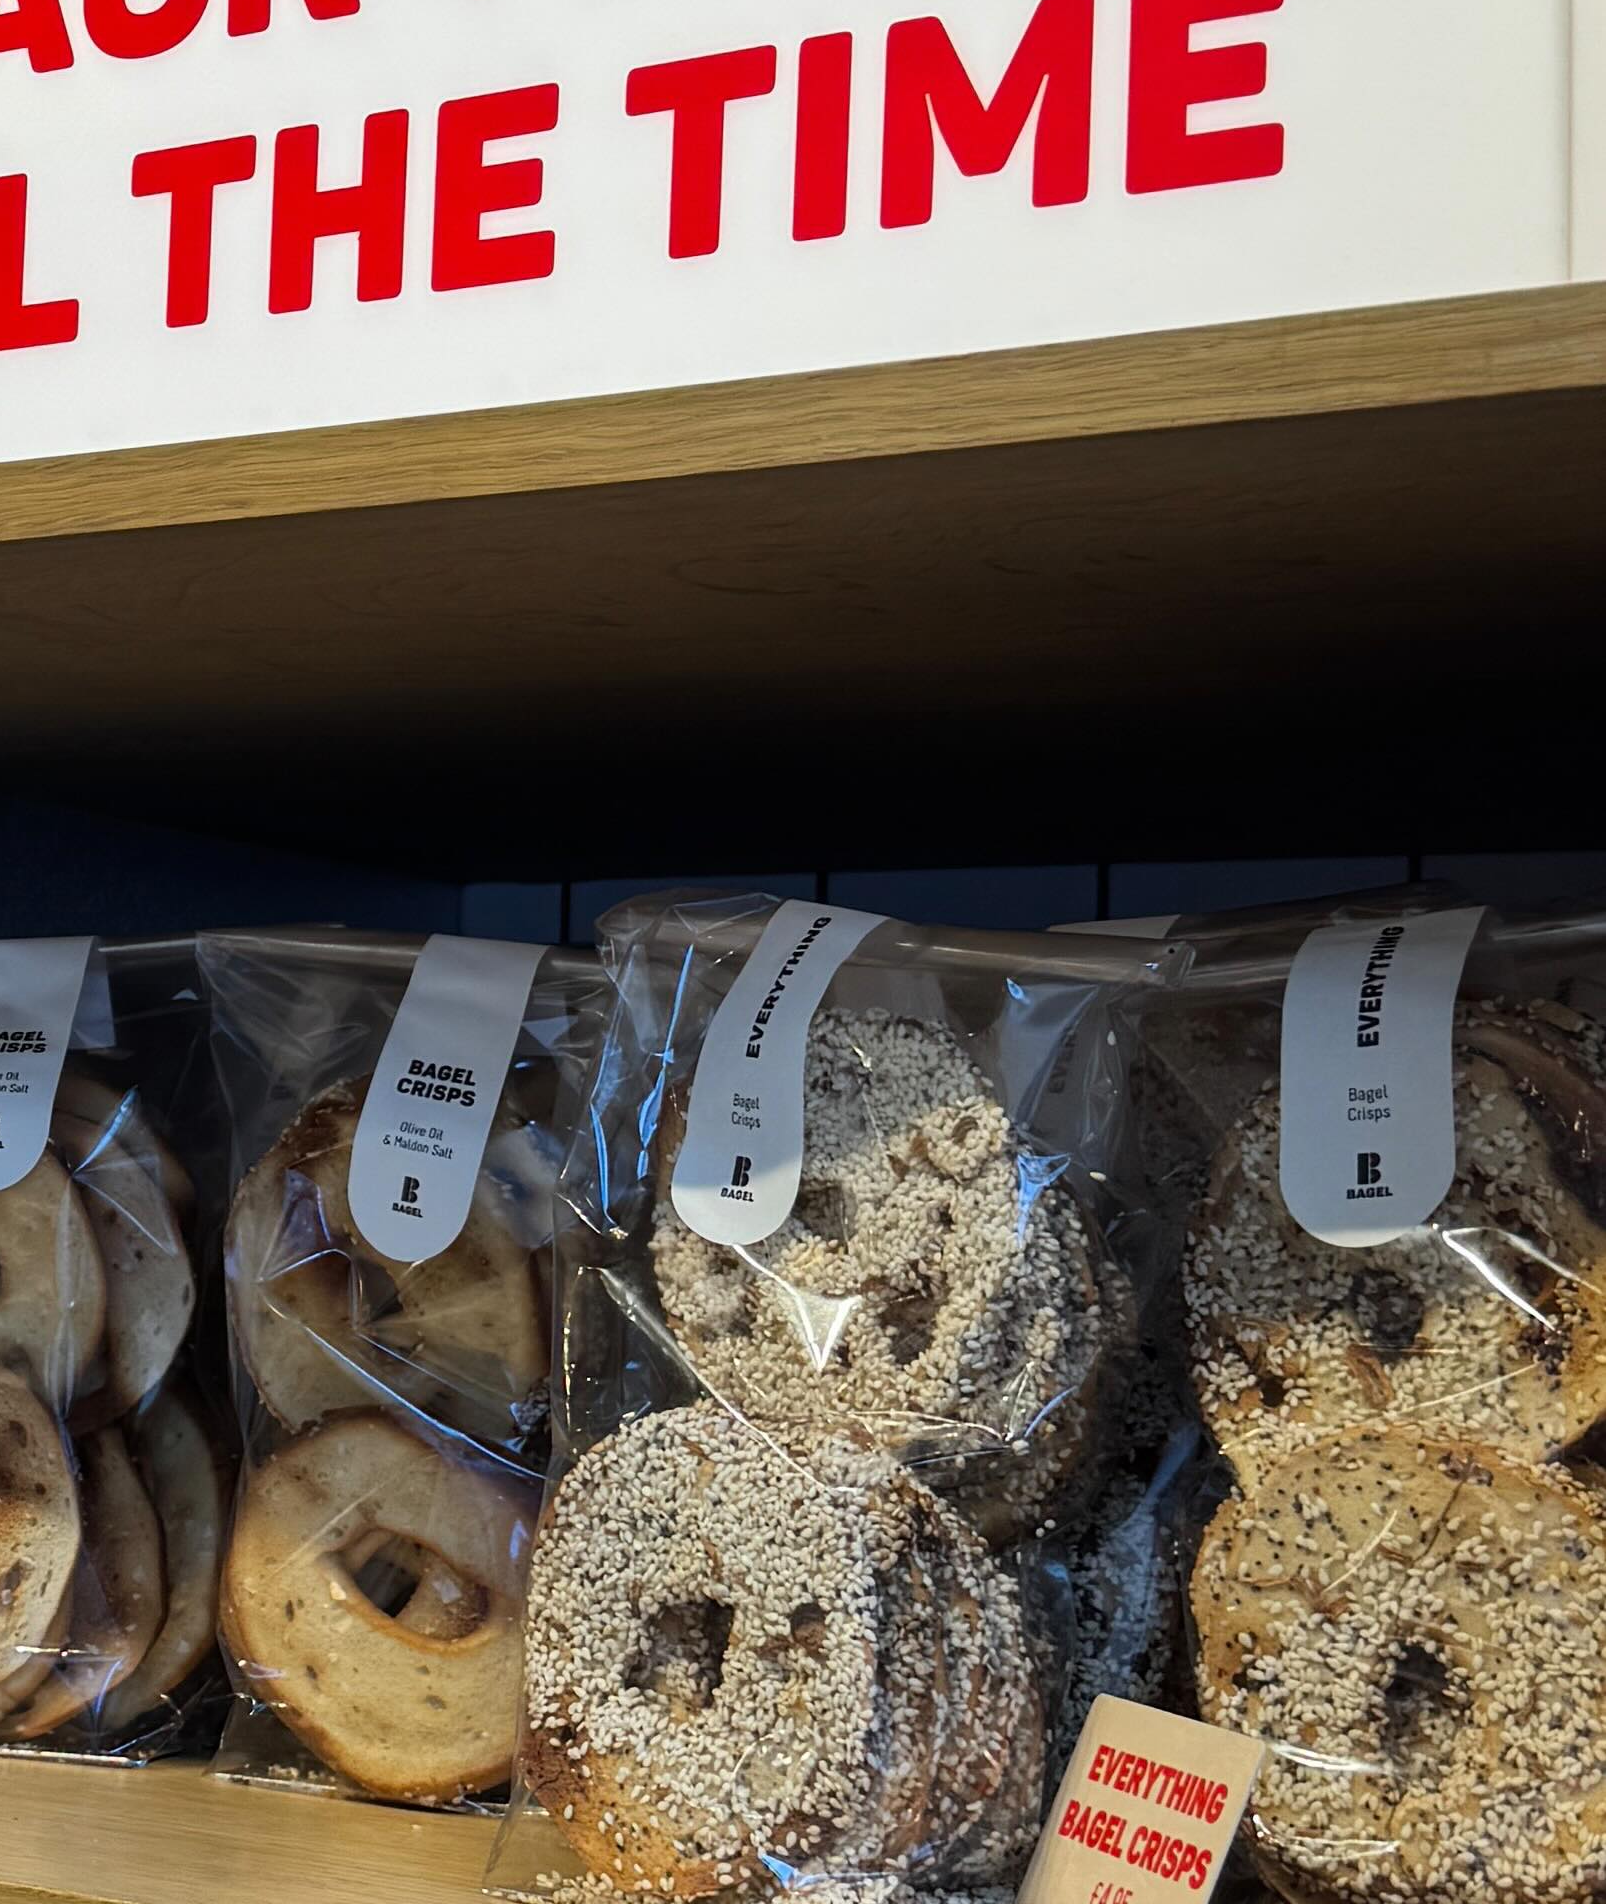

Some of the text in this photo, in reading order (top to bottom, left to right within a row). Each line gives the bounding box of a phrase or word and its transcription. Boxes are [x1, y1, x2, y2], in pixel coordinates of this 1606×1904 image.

[131, 83, 560, 327] THE
[745, 916, 833, 1060] EVERYTHING
[1357, 925, 1405, 1048] EVERYTHING
[6, 1070, 19, 1081] Oil
[408, 1059, 476, 1087] BAGEL
[9, 1082, 29, 1094] Salt
[396, 1078, 476, 1107] CRISPS
[1347, 1084, 1389, 1104] Bagel
[732, 1093, 760, 1111] Bagel
[1347, 1106, 1391, 1123] Crisps
[399, 1121, 444, 1141] Olive Oil
[731, 1112, 761, 1130] Crisps
[382, 1135, 454, 1160] & Maldon Salt
[731, 1155, 753, 1187] B
[1357, 1152, 1381, 1185] B
[400, 1176, 421, 1203] B
[720, 1187, 755, 1202] BAGEL
[1346, 1185, 1393, 1199] BAGEL
[1087, 1744, 1228, 1824] EVERYTHING
[1058, 1799, 1212, 1890] BAGEL CRISPS
